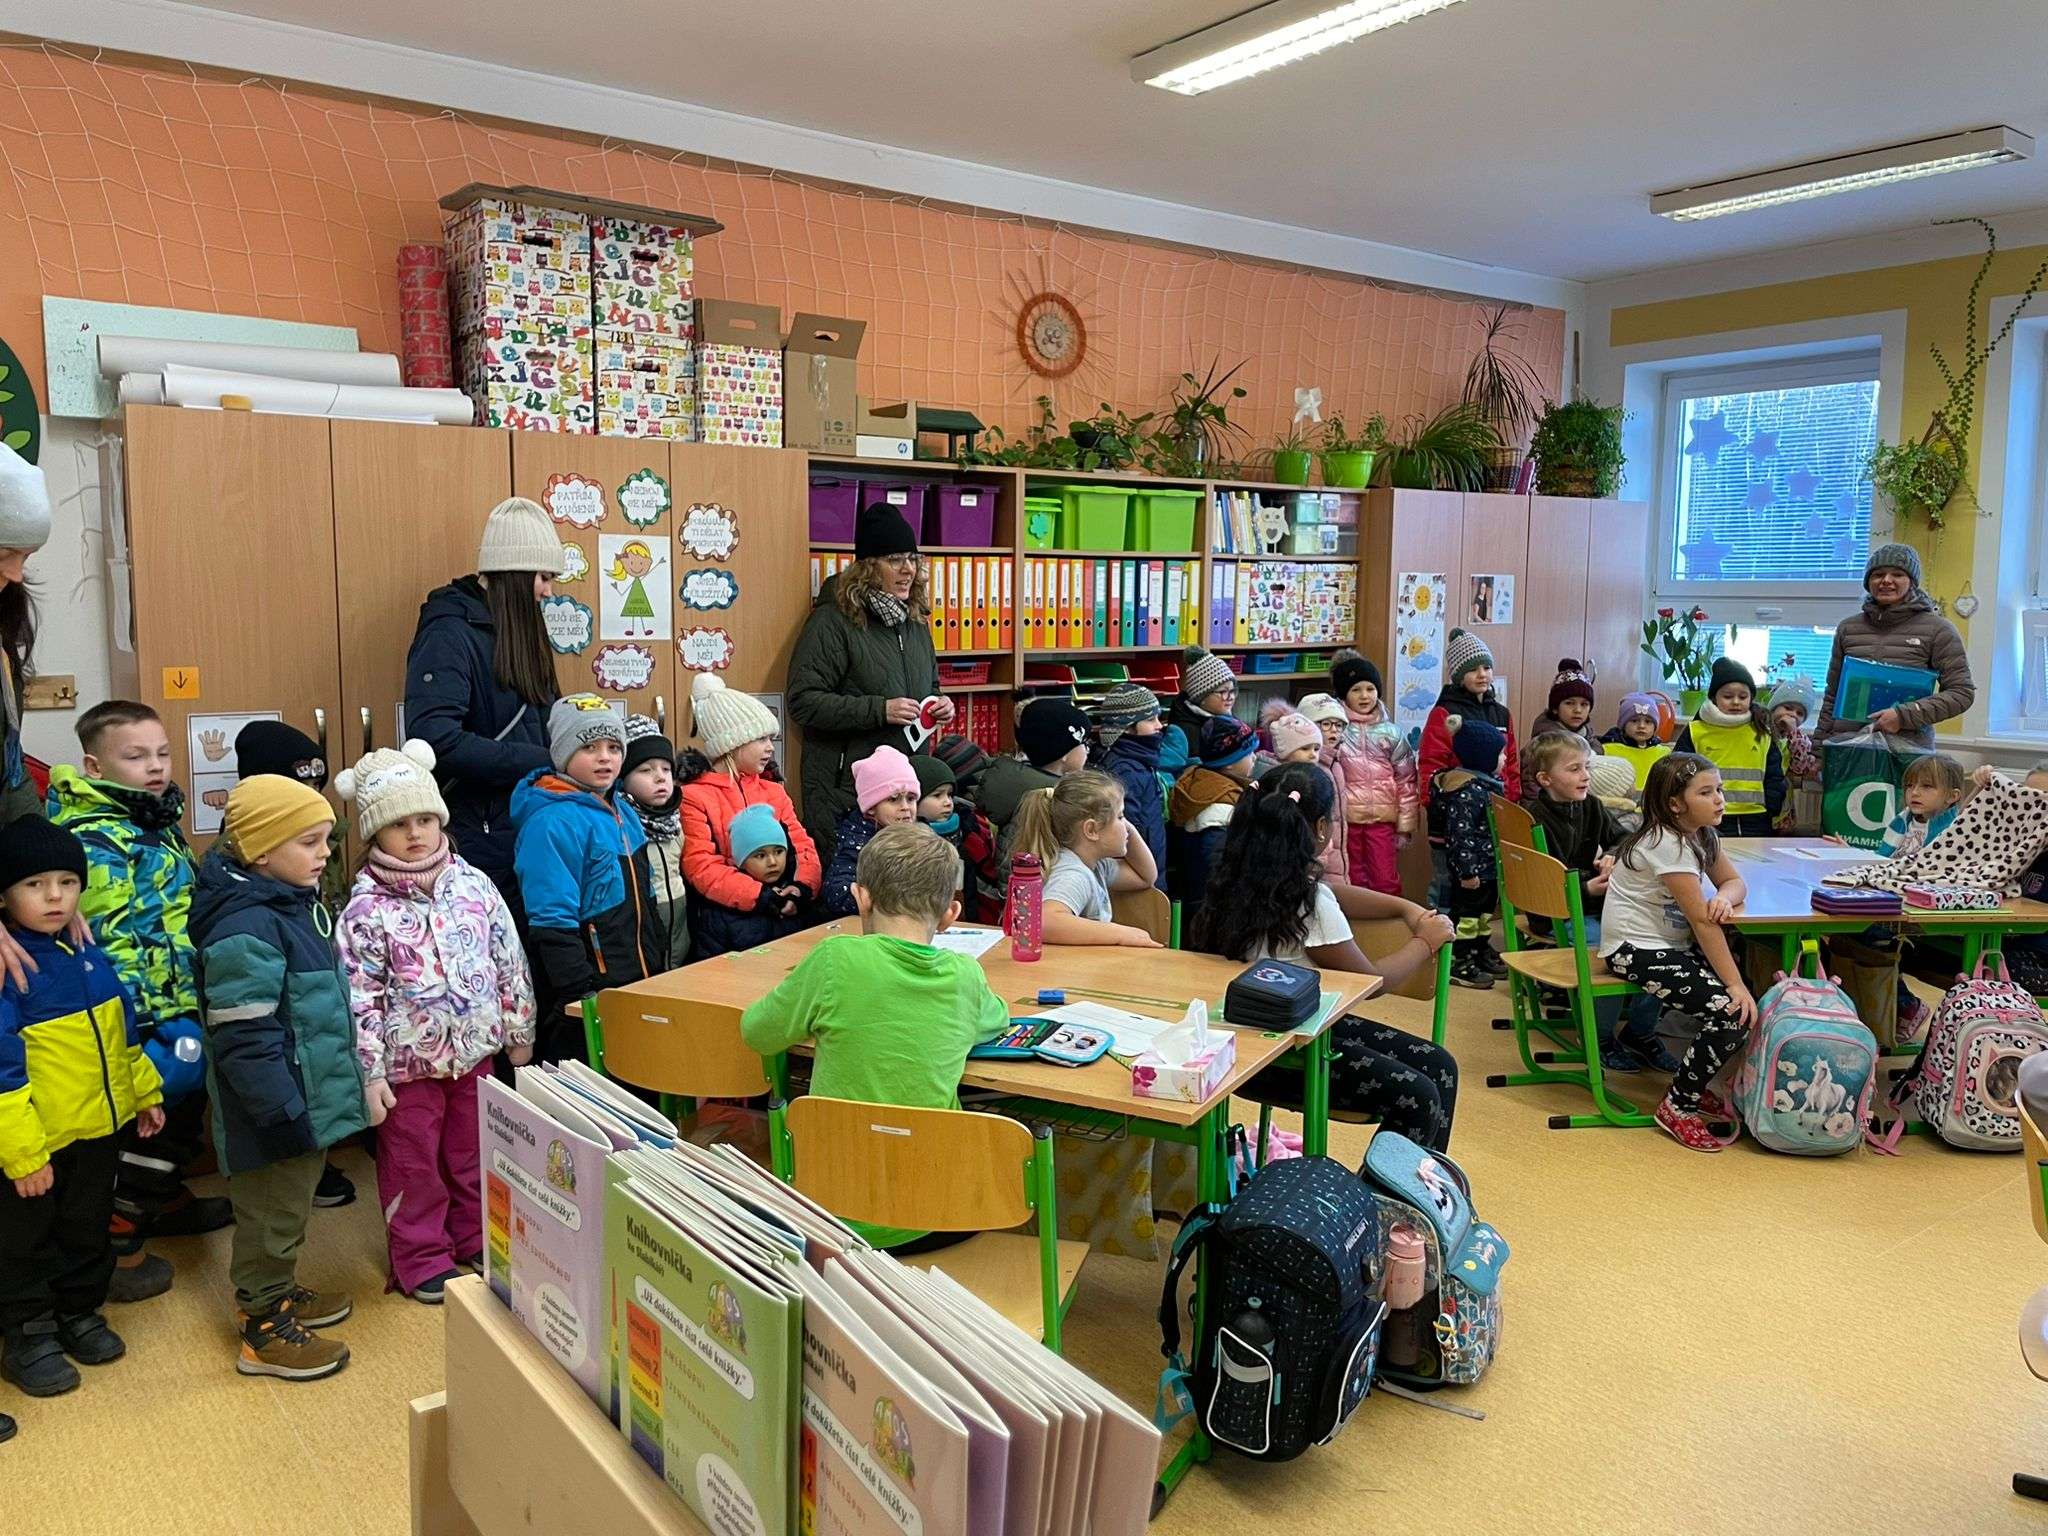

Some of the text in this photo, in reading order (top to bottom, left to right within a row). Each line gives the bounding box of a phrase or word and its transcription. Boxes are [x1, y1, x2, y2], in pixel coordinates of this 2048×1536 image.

[486, 1100, 536, 1147] Knihovnička
[626, 1214, 693, 1284] Knihovnička
[697, 1334, 714, 1360] celé
[859, 1459, 877, 1487] celé
